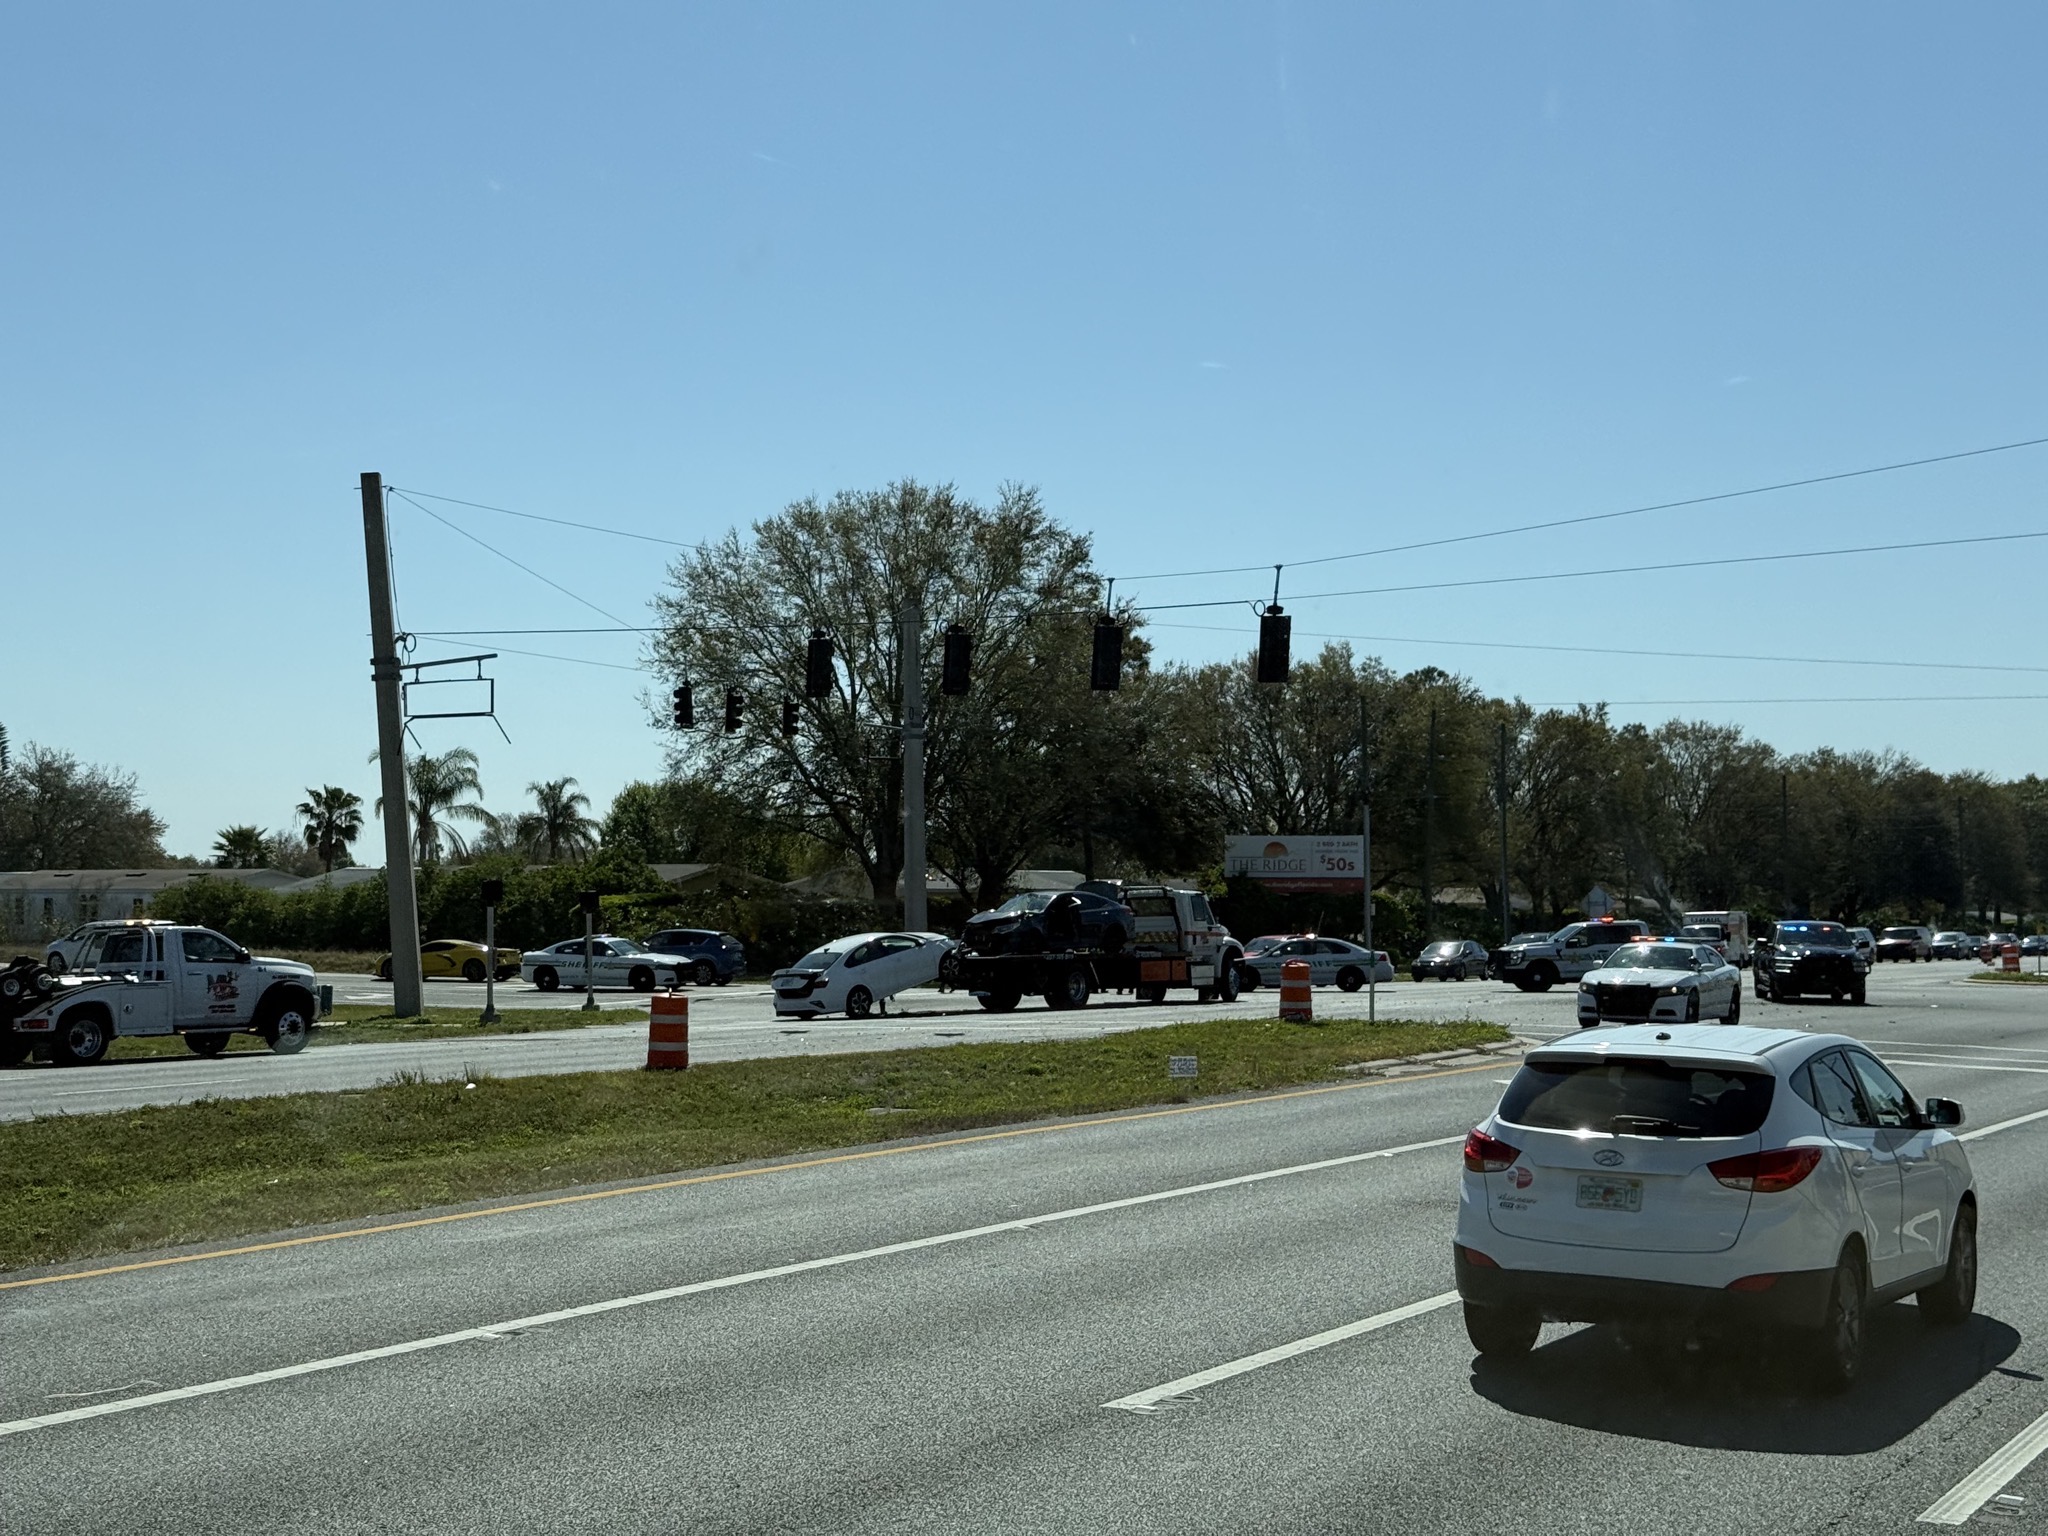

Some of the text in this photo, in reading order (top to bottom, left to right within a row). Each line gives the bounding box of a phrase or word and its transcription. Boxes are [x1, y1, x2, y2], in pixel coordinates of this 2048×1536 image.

[1231, 859, 1307, 871] THE RIDGE
[1320, 854, 1355, 872] $50s
